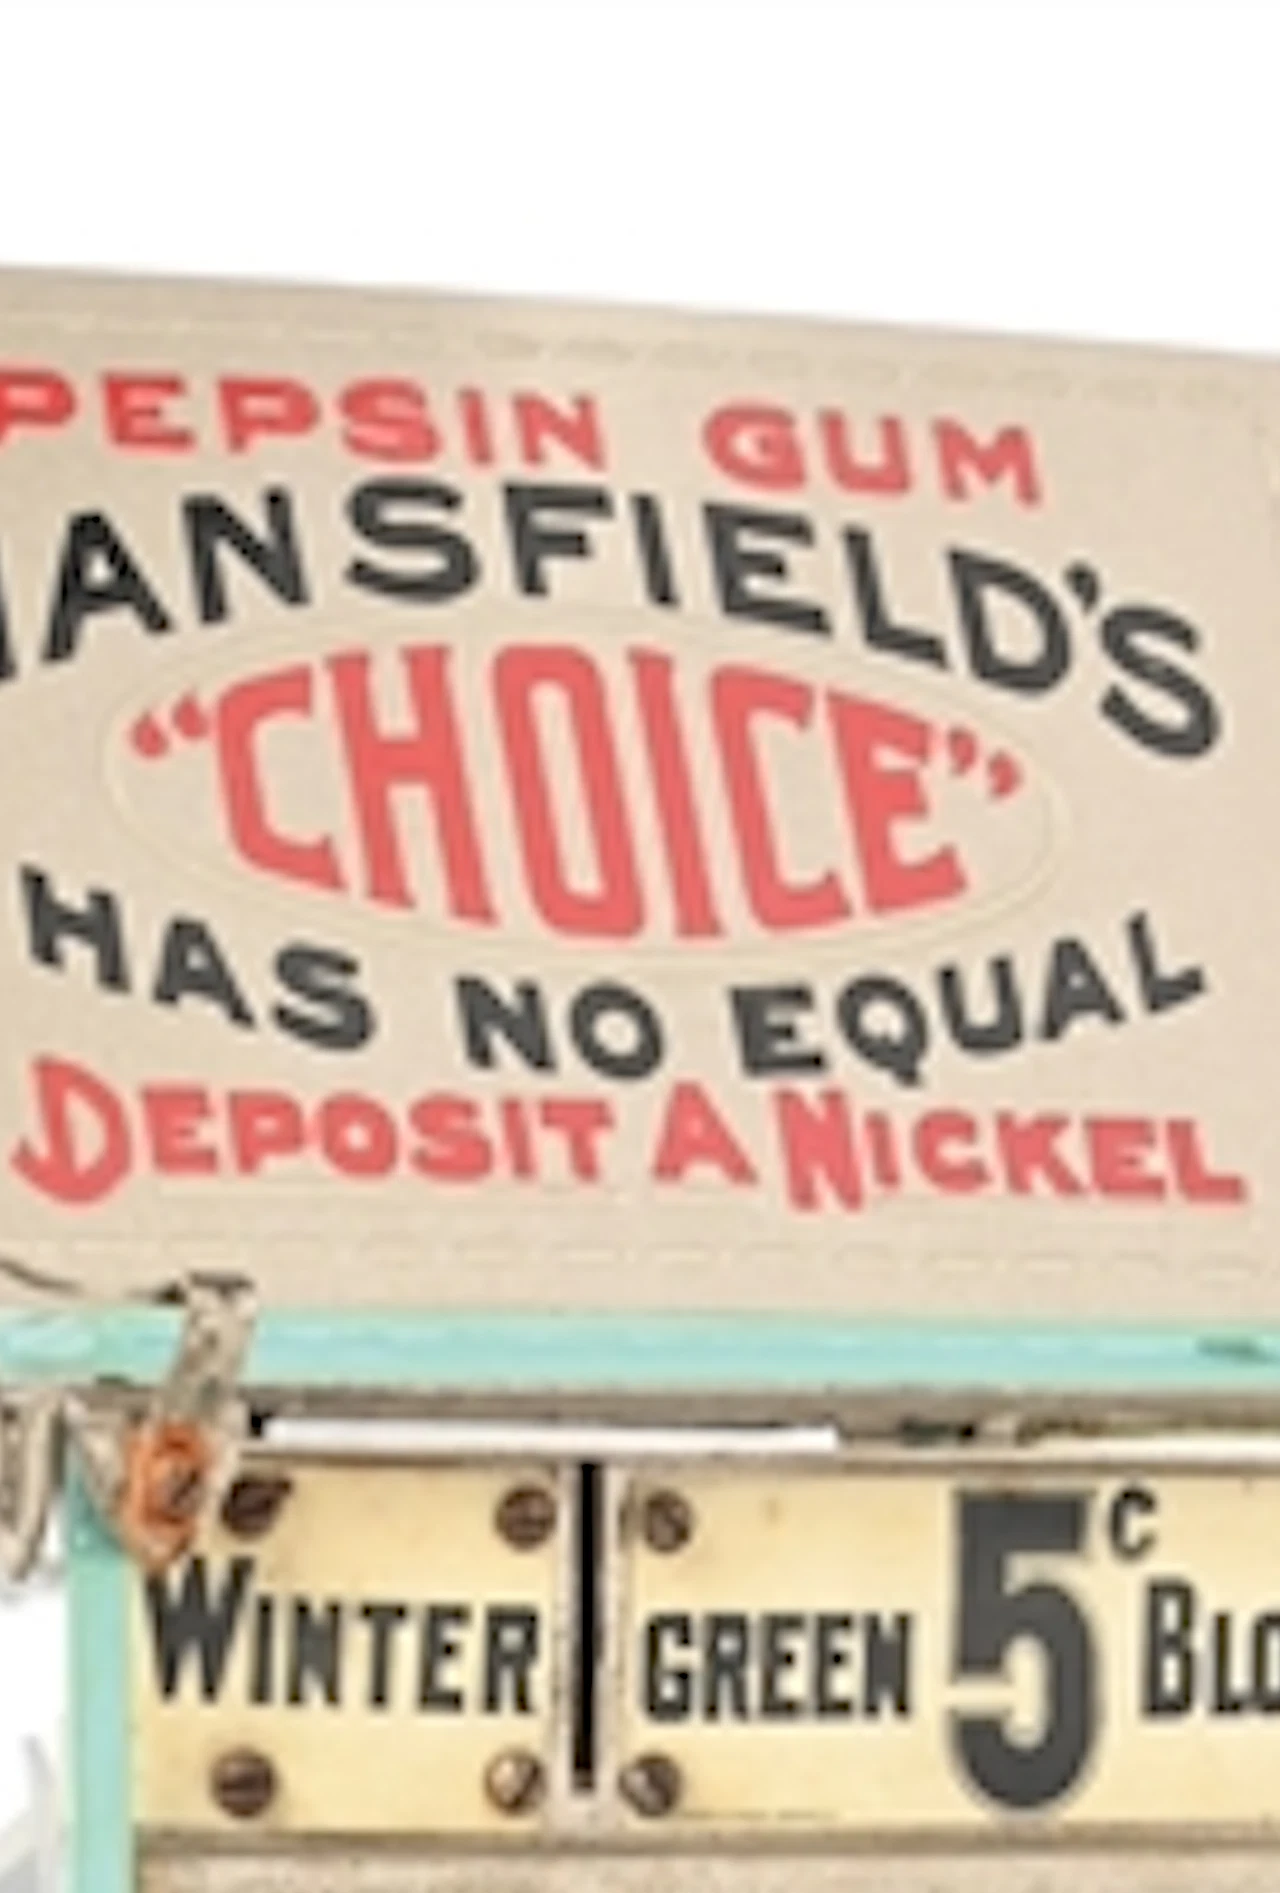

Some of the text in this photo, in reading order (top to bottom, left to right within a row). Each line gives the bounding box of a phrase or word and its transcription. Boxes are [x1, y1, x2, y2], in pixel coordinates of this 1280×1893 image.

[704, 404, 1038, 505] GUM
[21, 866, 1204, 1086] HAS NO EQUAL
[10, 1058, 1244, 1213] DEPOSIT A NICKEL
[143, 1554, 540, 1715] WINTER
[643, 1612, 911, 1722] GREEN
